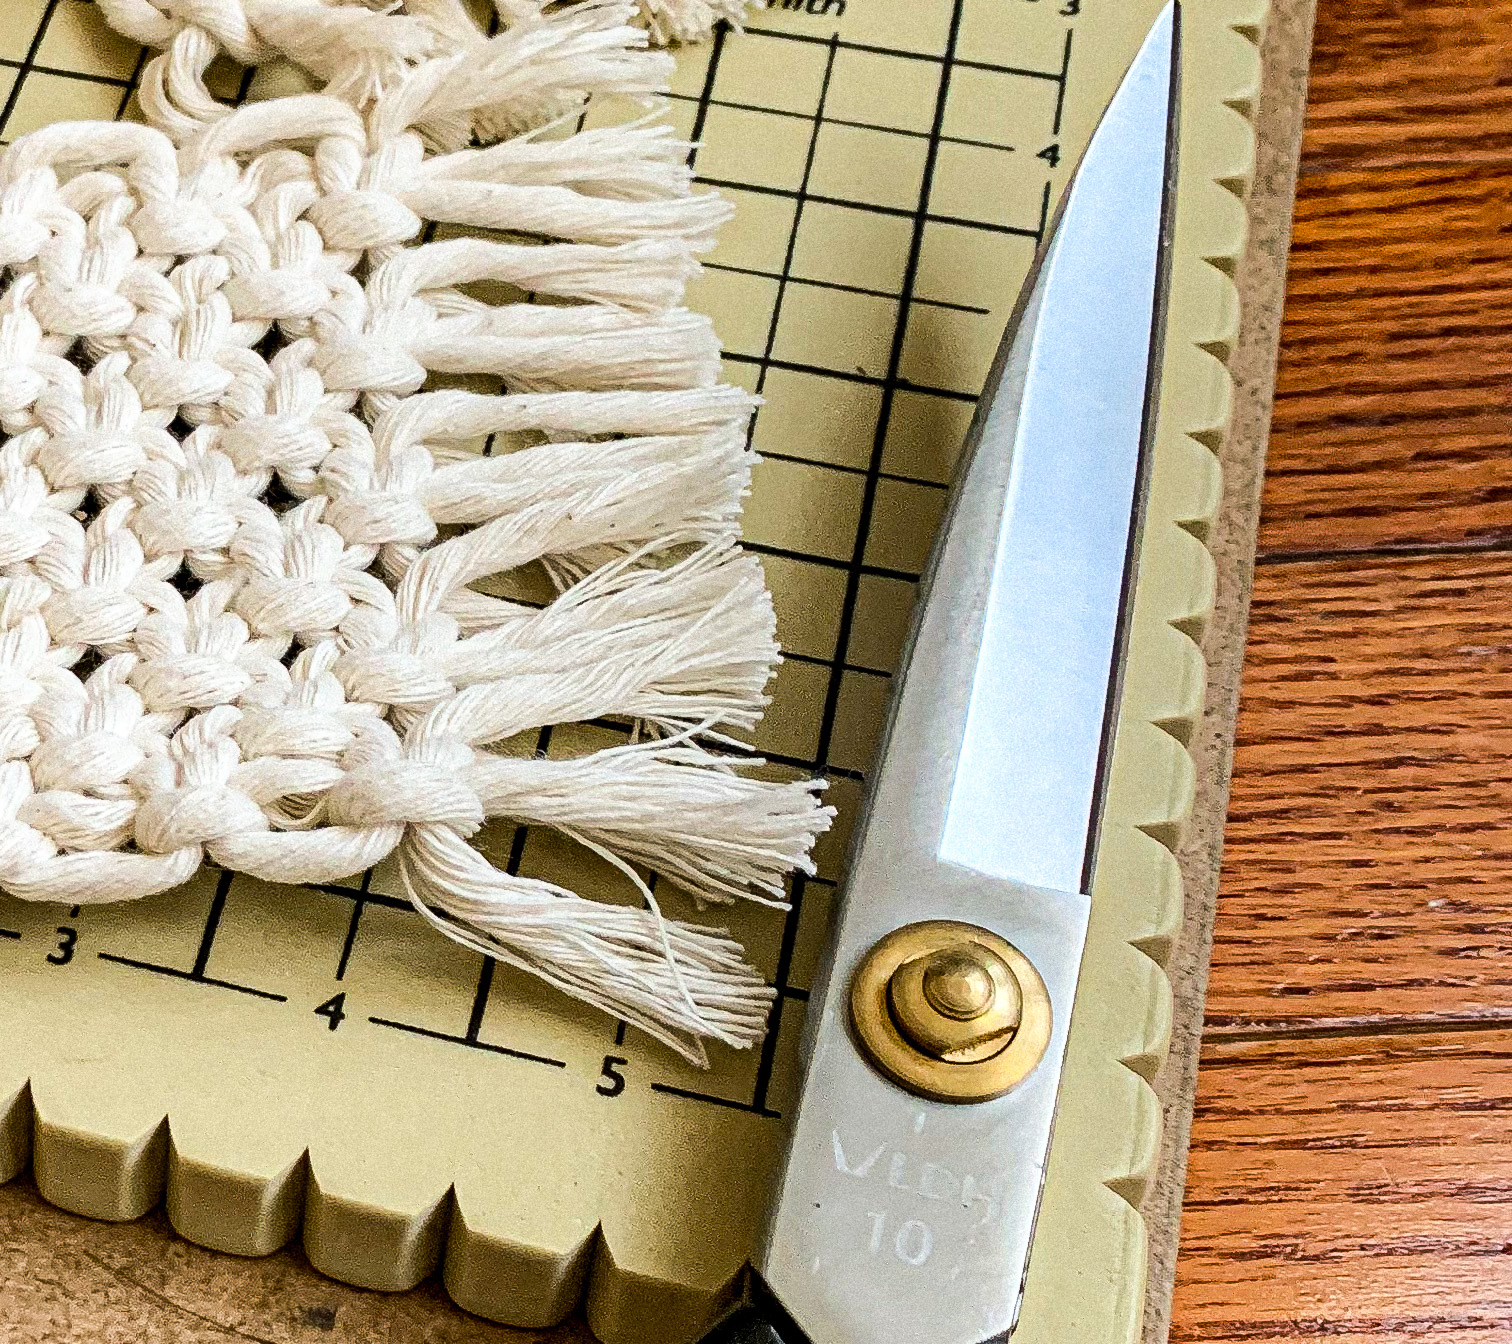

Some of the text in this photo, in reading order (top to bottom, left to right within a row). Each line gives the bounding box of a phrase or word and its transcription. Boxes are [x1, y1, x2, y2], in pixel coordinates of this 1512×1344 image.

[1036, 143, 1061, 168] 4
[46, 926, 628, 1097] 3 4 5
[866, 1209, 933, 1267] 10
